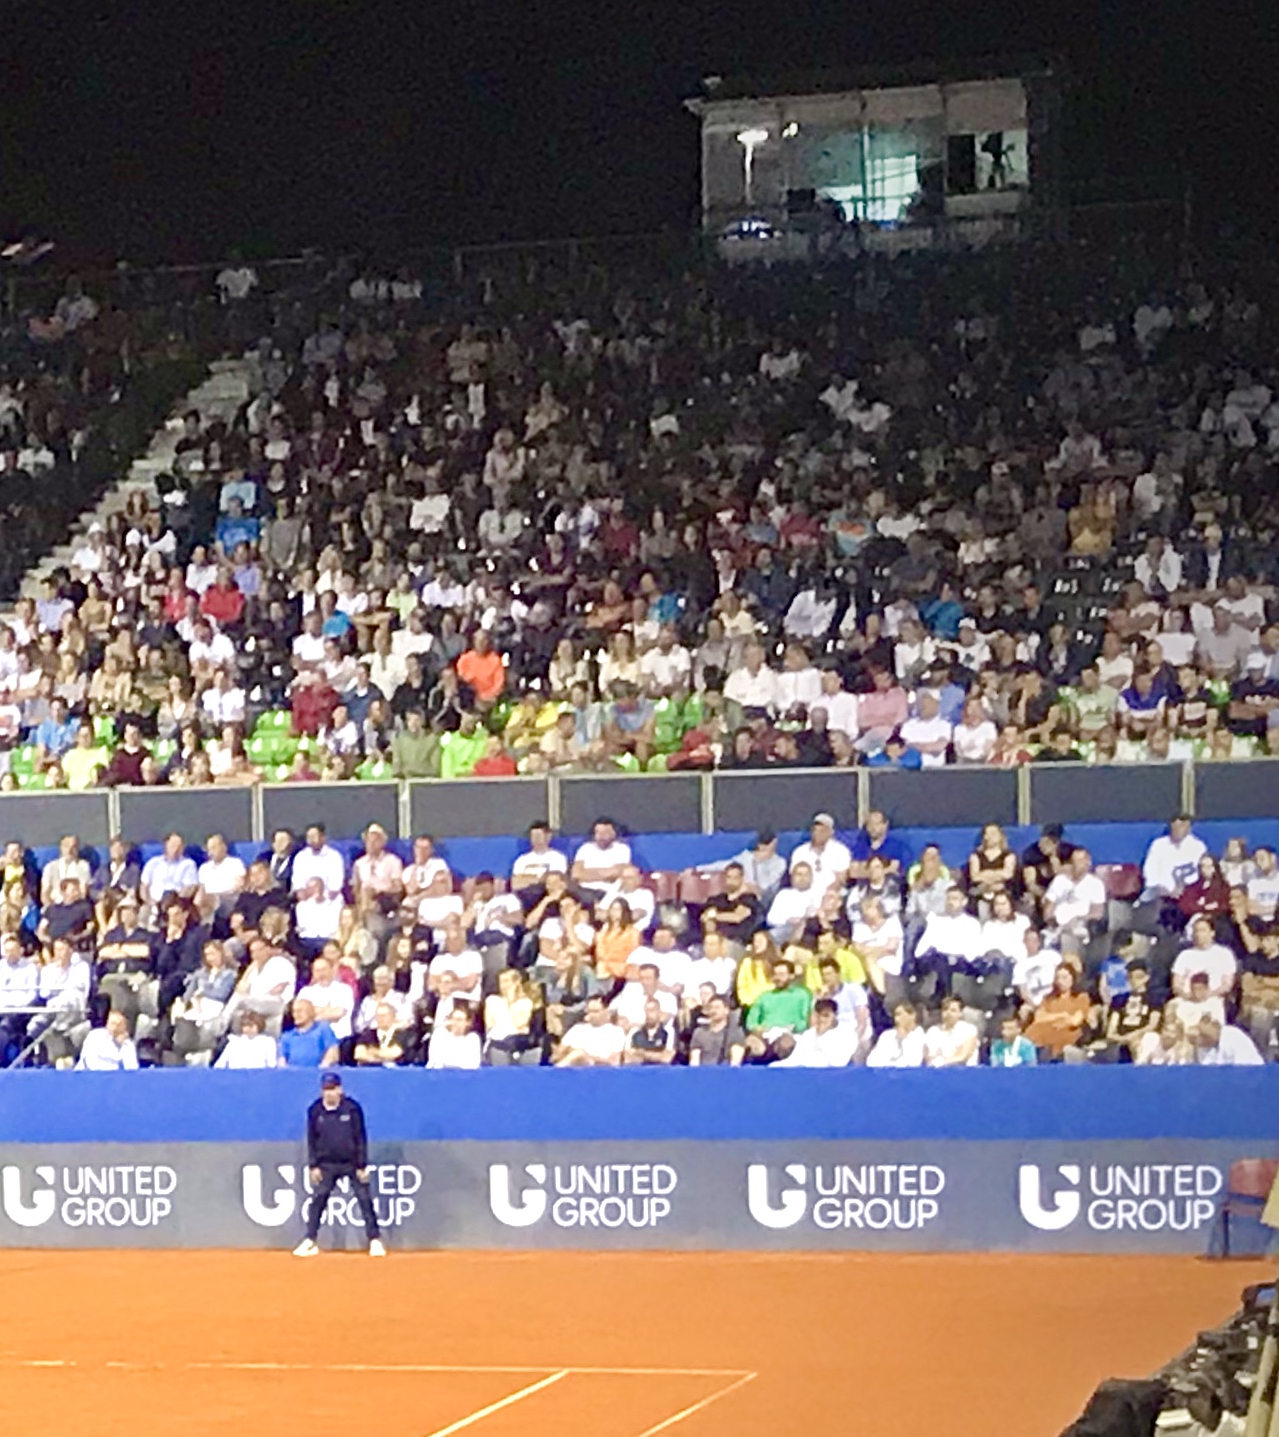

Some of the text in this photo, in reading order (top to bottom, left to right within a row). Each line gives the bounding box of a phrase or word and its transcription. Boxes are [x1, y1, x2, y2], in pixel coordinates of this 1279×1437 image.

[63, 1165, 178, 1196] UNITED
[555, 1164, 678, 1195] UNITED
[814, 1164, 946, 1196] UNITED
[1089, 1164, 1223, 1197] UNITED
[61, 1196, 173, 1228] GROUP
[552, 1196, 672, 1228] GROUP
[812, 1197, 940, 1230] GROUP
[1086, 1197, 1216, 1231] GROUP
